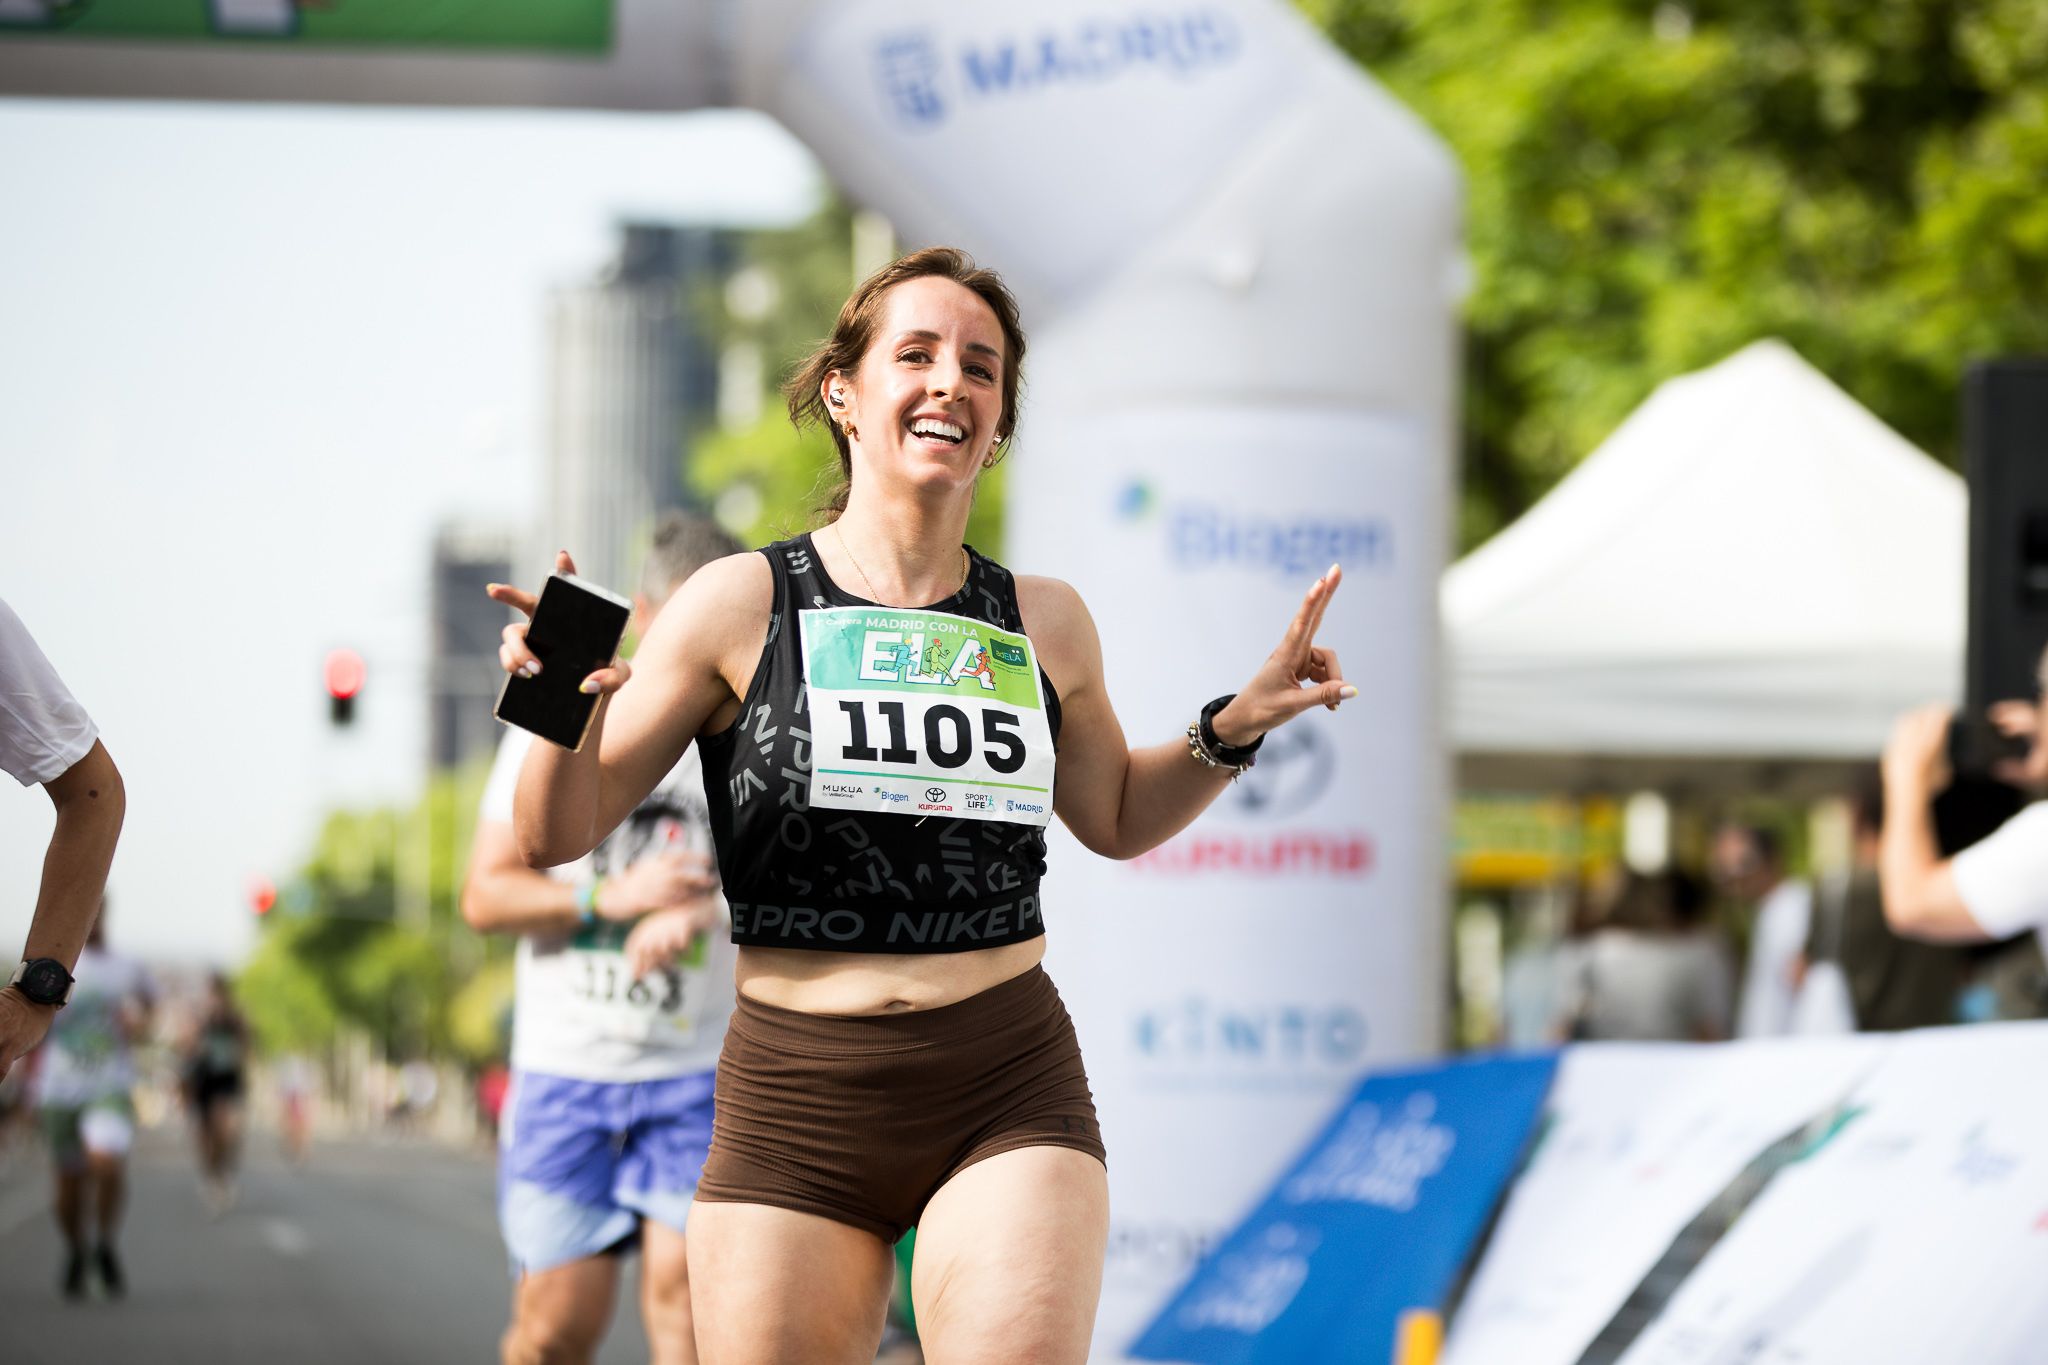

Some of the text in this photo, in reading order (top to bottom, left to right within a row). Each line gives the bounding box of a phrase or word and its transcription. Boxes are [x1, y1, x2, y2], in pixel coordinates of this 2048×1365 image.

[1169, 506, 1391, 578] Biogen
[866, 617, 925, 630] MADRID
[929, 622, 959, 634] CON
[962, 626, 978, 637] LA
[858, 630, 996, 691] ELA
[838, 699, 1027, 774] 1105
[822, 784, 864, 794] MUKUA
[881, 791, 909, 803] Biogen
[965, 793, 988, 801] SPORT
[967, 801, 985, 809] LIFE
[1015, 804, 1044, 813] MADRID
[751, 904, 865, 942] PRO
[886, 903, 1014, 944] NIKE
